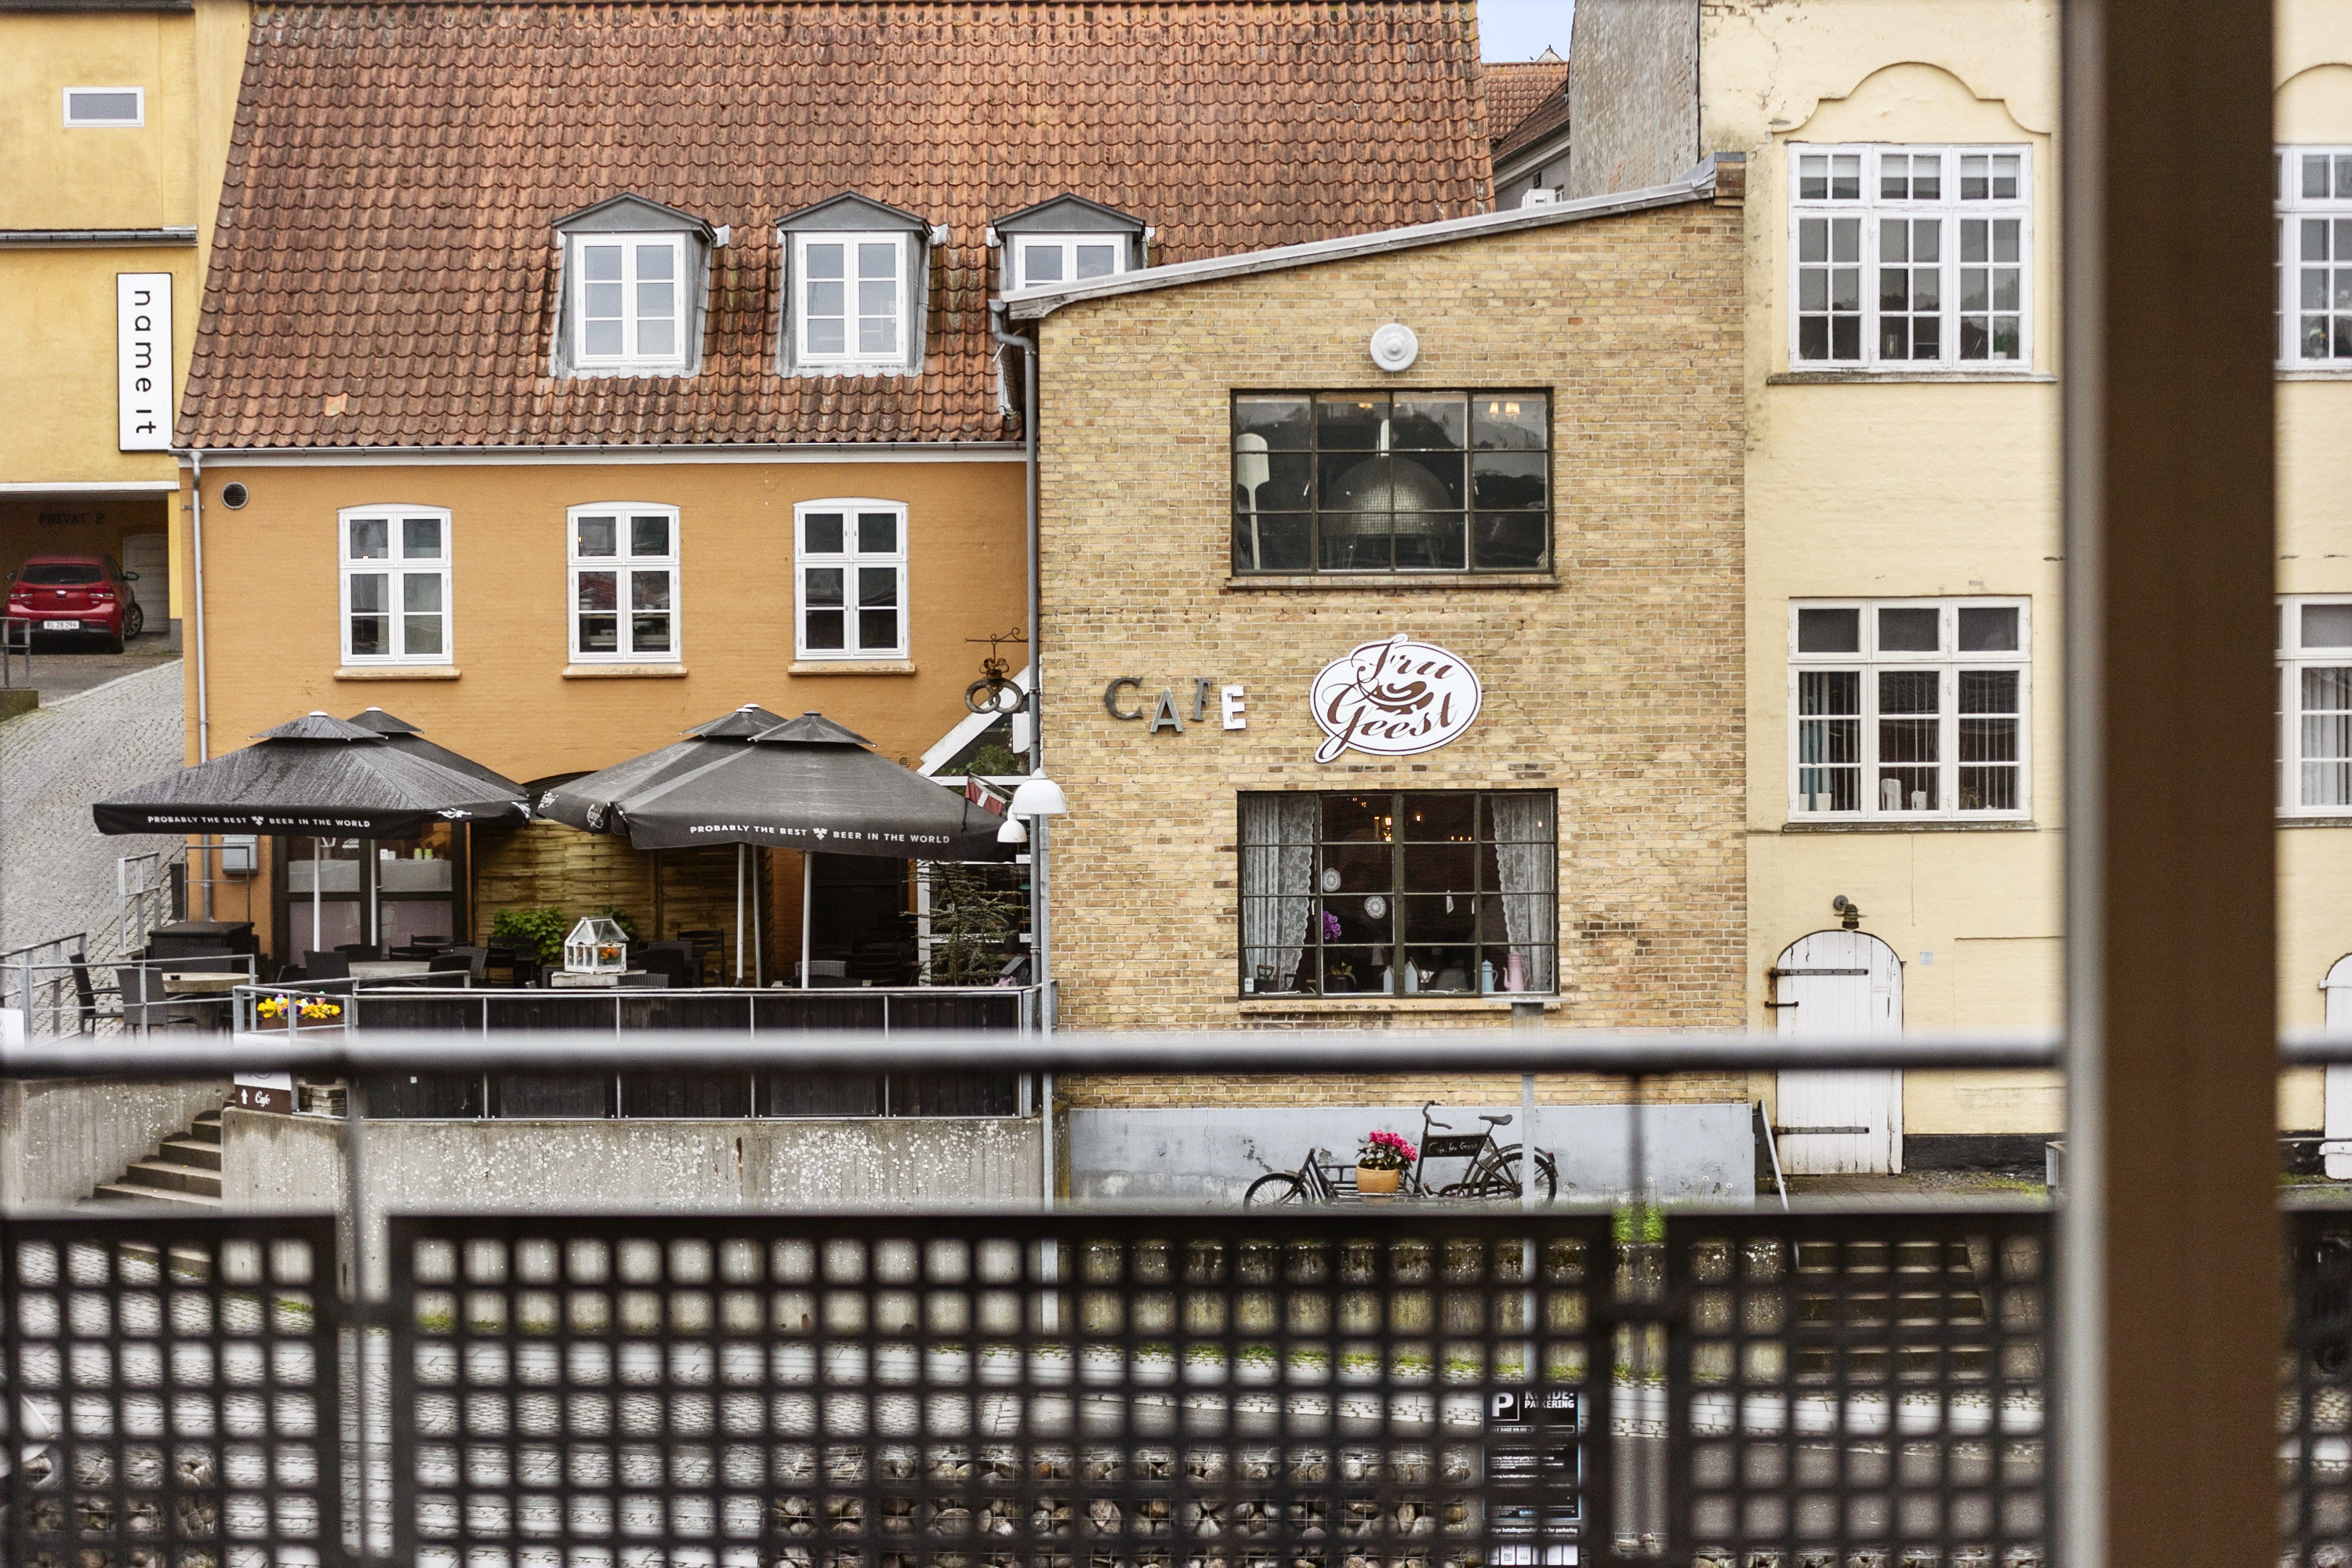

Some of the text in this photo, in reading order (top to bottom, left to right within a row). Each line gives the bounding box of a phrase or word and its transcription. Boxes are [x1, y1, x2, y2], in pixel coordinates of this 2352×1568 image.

[134, 290, 152, 393] name
[39, 512, 105, 525] PRIVAT P
[1350, 635, 1456, 681] Fru
[1104, 676, 1247, 734] CAFE
[1321, 666, 1460, 760] Geest
[336, 819, 371, 828] WORLD
[690, 825, 750, 833] PROBABLY
[779, 827, 808, 836] BEST
[833, 831, 862, 840] BEER
[867, 832, 879, 840] IN
[884, 833, 905, 842] THE
[910, 834, 950, 844] WORLD
[254, 1091, 271, 1108] Cafe
[1491, 1392, 1514, 1417] P
